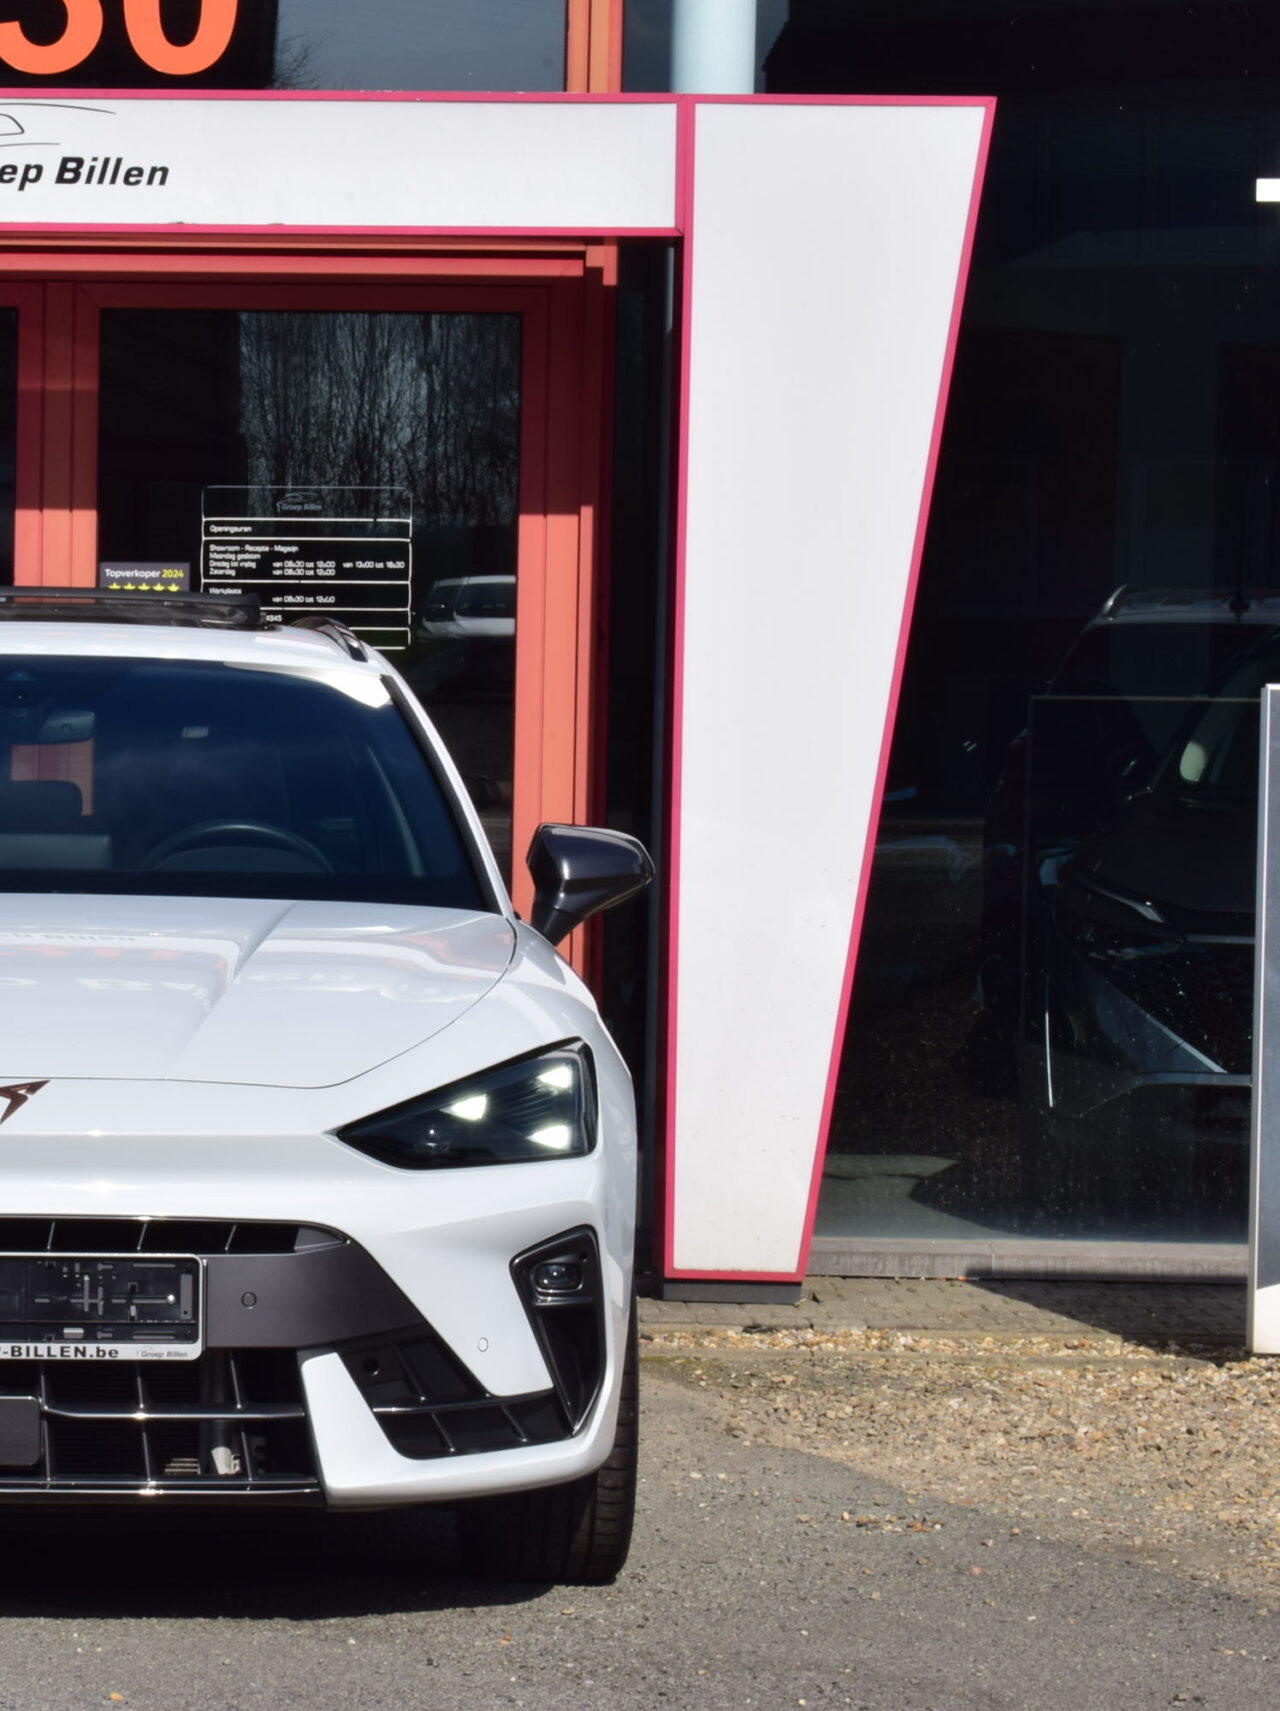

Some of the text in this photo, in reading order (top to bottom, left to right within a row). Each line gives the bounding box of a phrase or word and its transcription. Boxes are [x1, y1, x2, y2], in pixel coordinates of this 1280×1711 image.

[54, 156, 170, 187] Billen
[210, 525, 252, 534] Openingsuren
[105, 568, 184, 579] Topverkoper 2024
[141, 1350, 164, 1358] Groep
